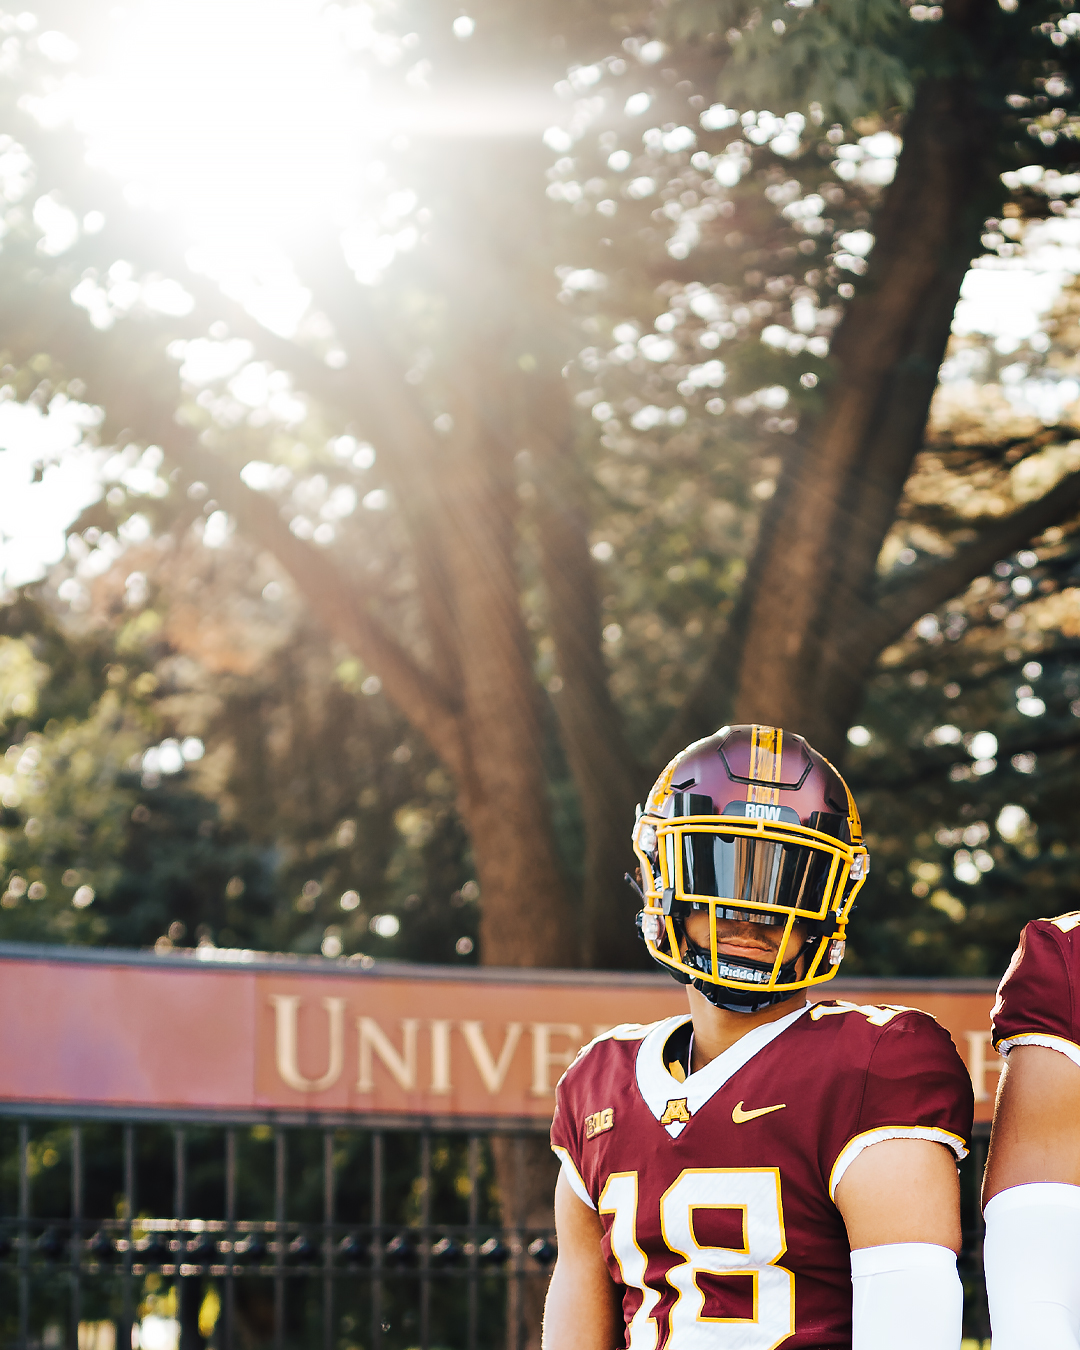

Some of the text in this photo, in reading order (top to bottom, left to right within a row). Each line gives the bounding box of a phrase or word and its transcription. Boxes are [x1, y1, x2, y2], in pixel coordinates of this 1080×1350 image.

[745, 803, 782, 822] ROW
[719, 965, 763, 982] Riddell
[268, 993, 602, 1098] UNIVE
